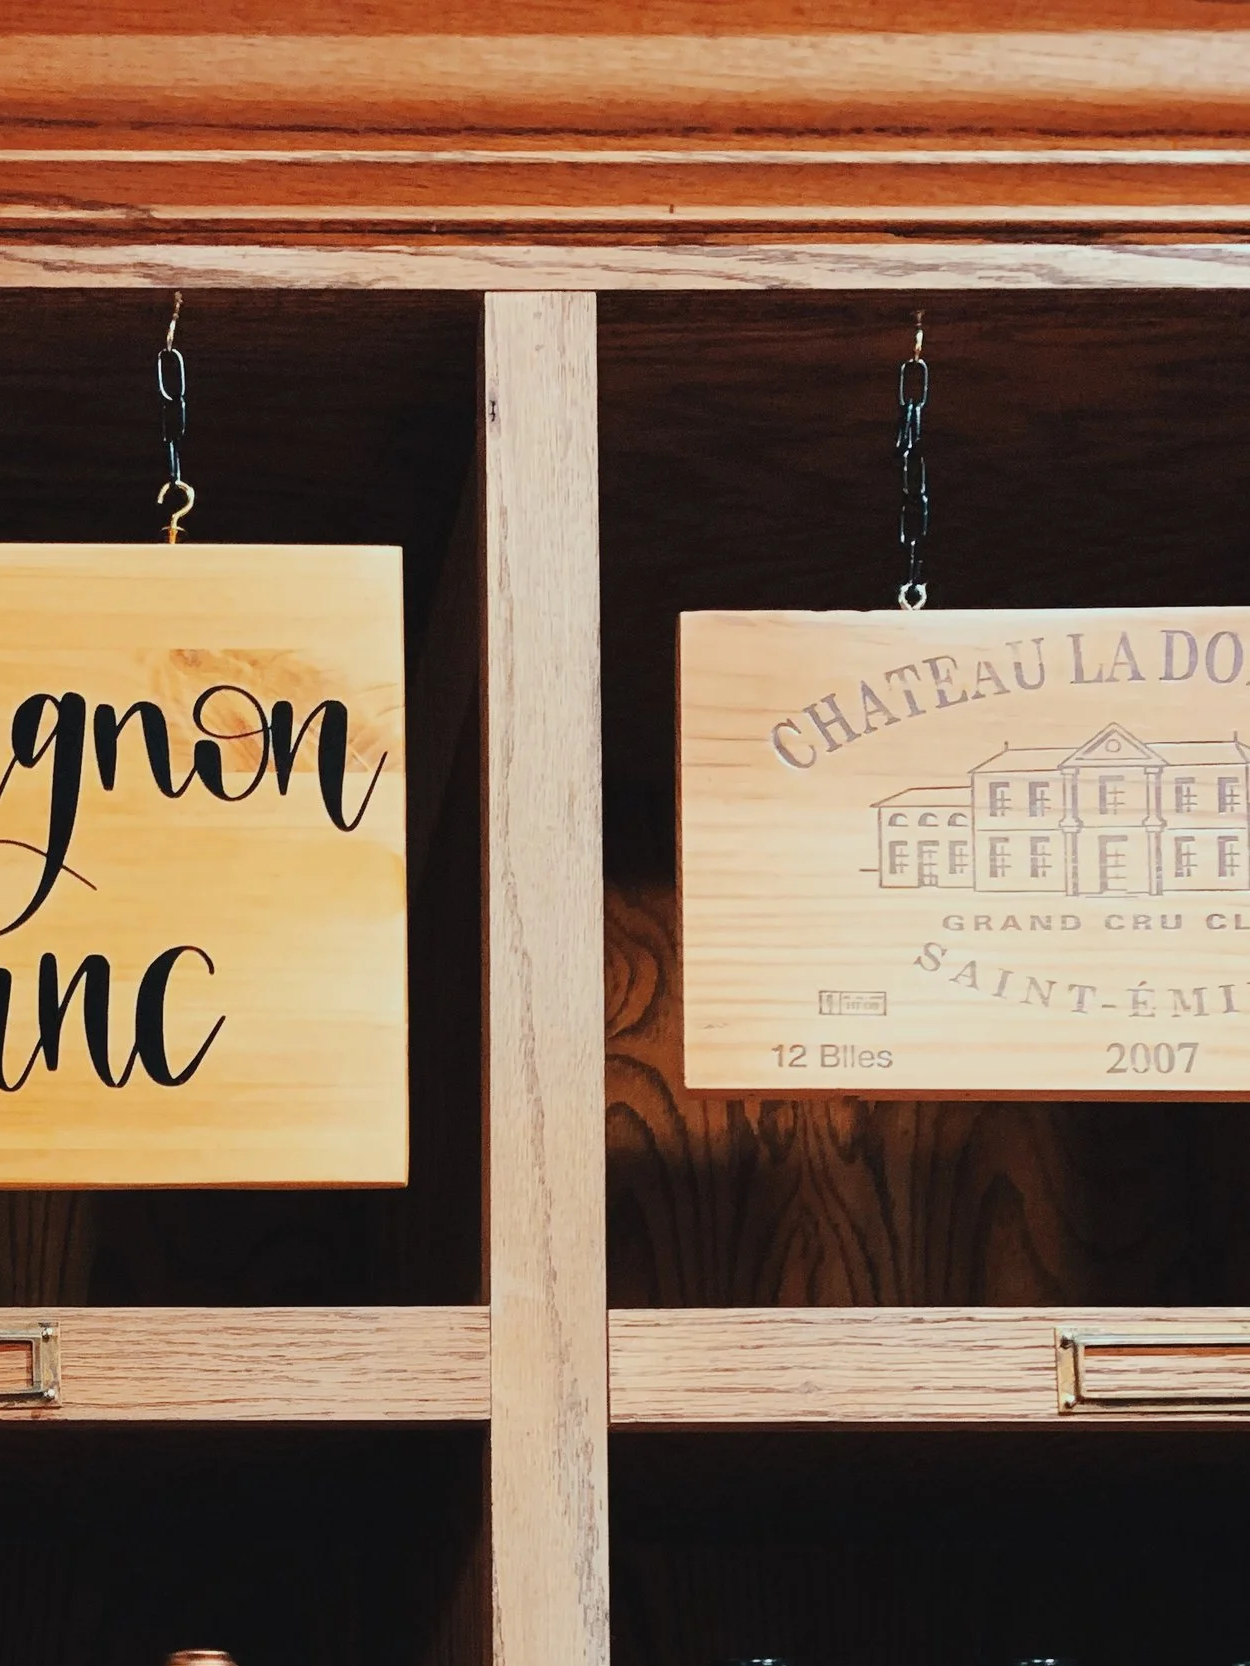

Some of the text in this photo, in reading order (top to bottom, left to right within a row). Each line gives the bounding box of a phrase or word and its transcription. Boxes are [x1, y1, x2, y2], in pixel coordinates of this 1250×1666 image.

[770, 629, 1250, 771] CHATEAU LA DO
[941, 914, 1083, 932] GRAND
[1104, 914, 1183, 931] CRU
[913, 941, 1250, 1018] SAINT-ÉMI
[771, 1044, 808, 1068] 12
[1106, 1041, 1199, 1074] 2007
